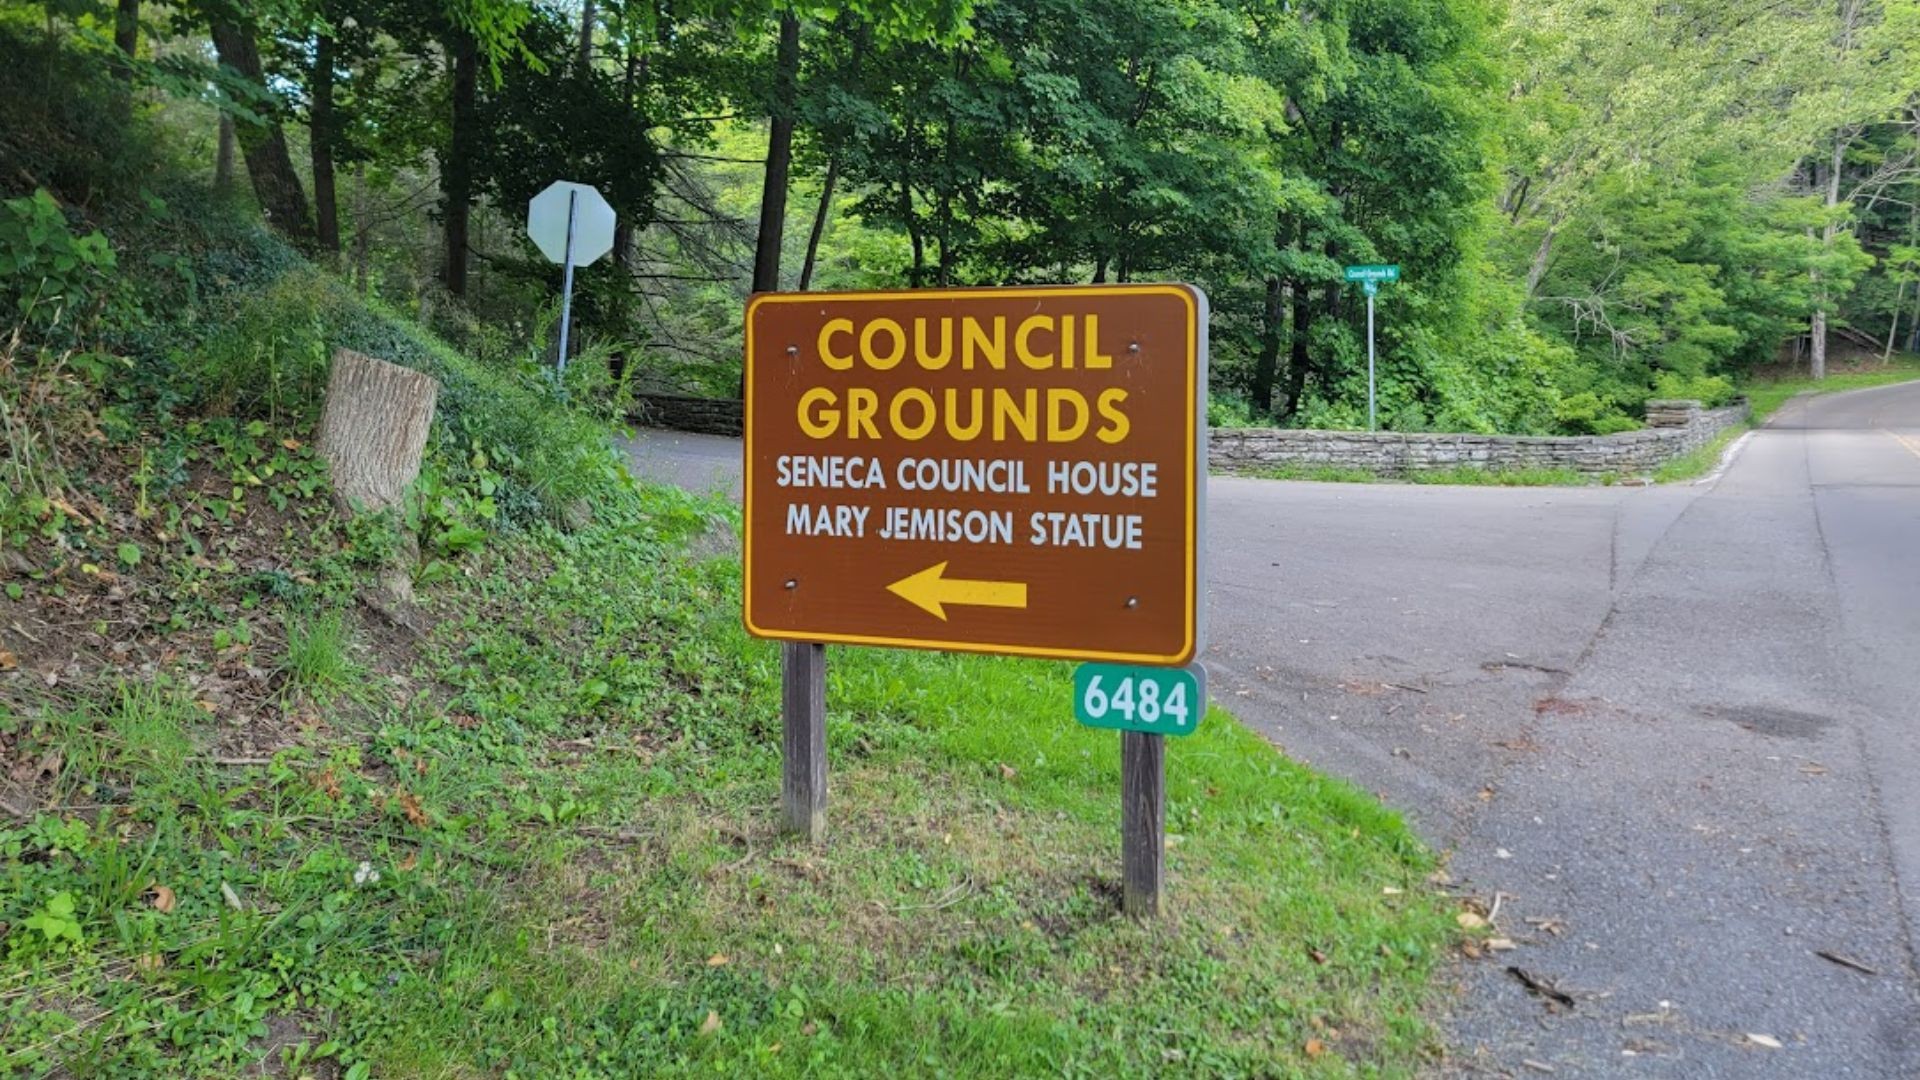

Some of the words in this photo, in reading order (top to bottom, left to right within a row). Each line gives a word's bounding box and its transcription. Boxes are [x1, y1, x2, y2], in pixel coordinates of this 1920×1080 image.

[818, 314, 1113, 370] COUNCIL
[797, 388, 1131, 443] GROUNDS
[777, 456, 886, 489] SENECA
[897, 458, 1030, 493] COUNCIL
[1048, 461, 1158, 498] HOUSE
[786, 504, 870, 538] MARY
[880, 507, 1013, 544] JEMISON
[1030, 512, 1143, 549] STATUE
[1084, 675, 1189, 725] 6484
